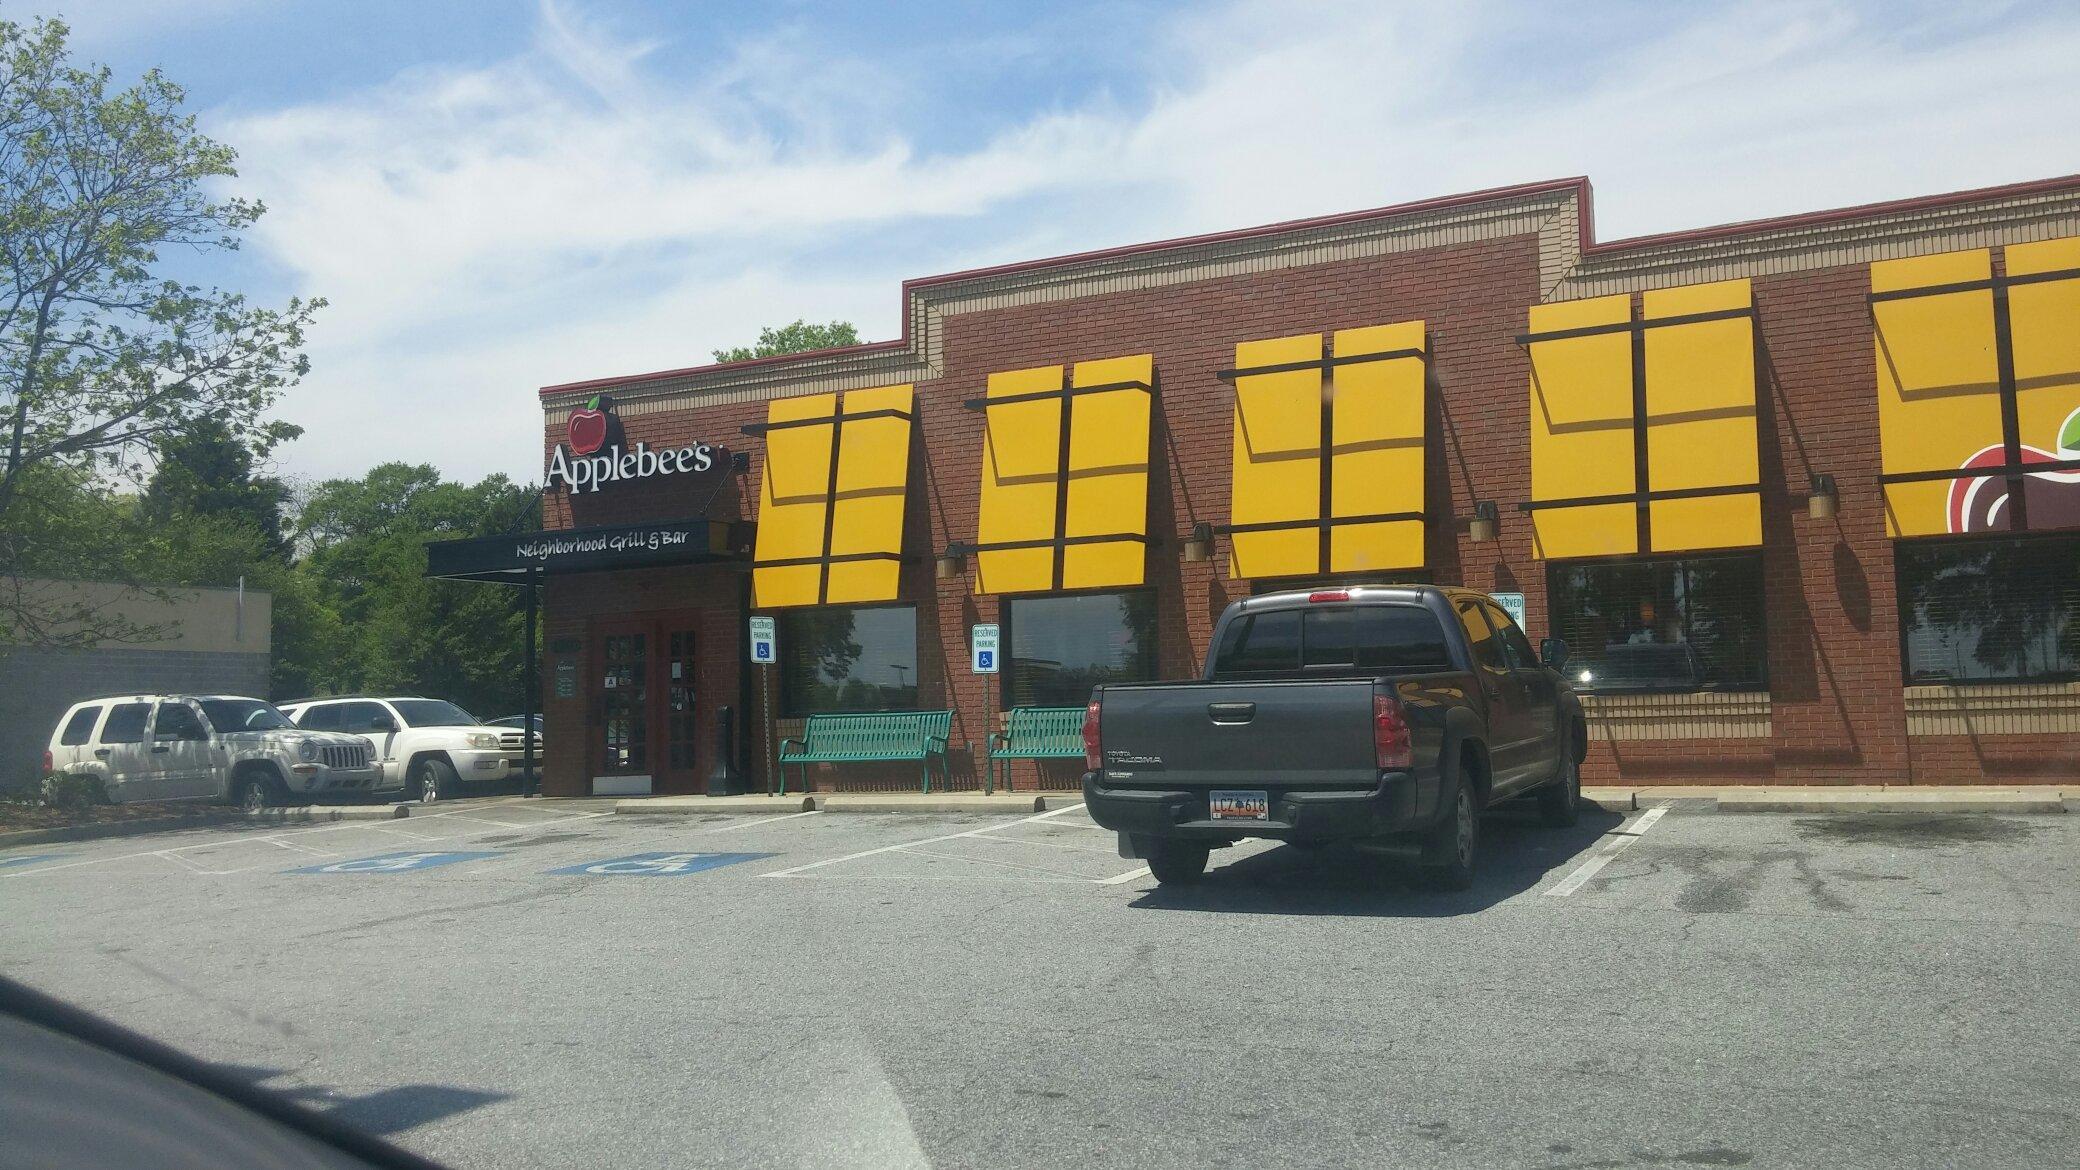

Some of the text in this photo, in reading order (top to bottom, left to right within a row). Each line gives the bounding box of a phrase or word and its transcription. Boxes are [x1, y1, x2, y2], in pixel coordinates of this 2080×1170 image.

[543, 441, 712, 495] Applebee's
[516, 530, 689, 560] Neighborhood Grill & Bar
[1497, 598, 1521, 607] SERVED
[753, 631, 772, 640] PARKING
[974, 629, 997, 637] RESERVED
[975, 640, 996, 648] PARKING
[1213, 798, 1265, 812] LCZ 618
